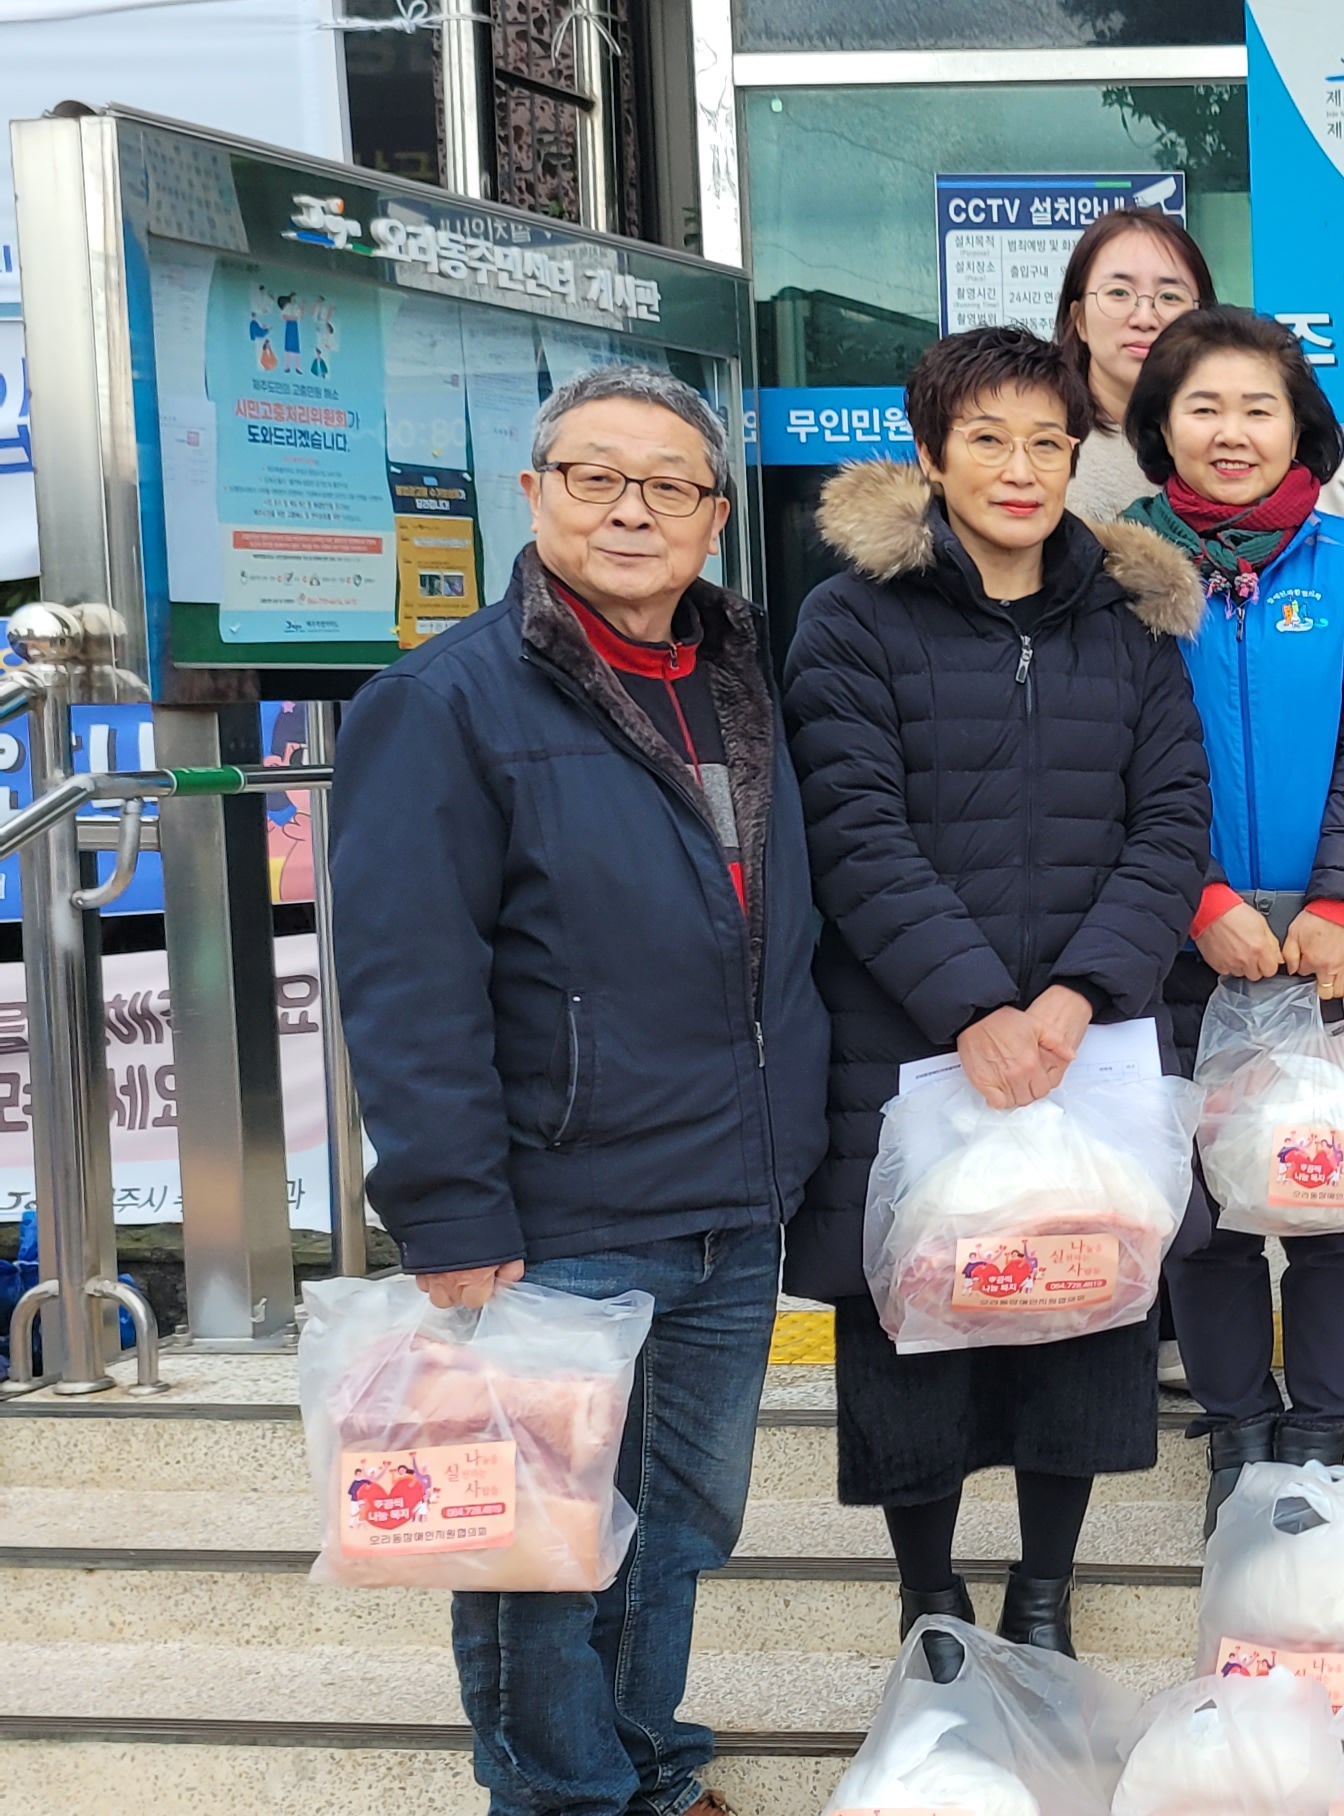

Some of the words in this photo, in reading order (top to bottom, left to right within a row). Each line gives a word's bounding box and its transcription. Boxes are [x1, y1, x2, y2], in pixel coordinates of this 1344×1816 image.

[949, 197, 1020, 224] CCTV
[954, 235, 996, 250] 설치목적
[1007, 239, 1047, 253] 범죄예방
[1049, 240, 1059, 252] 및
[370, 216, 575, 305] 오라동주민센터
[584, 268, 661, 322] 게시판
[955, 259, 996, 274] 설치장소
[1010, 264, 1049, 279] 출입구내
[956, 286, 996, 301] 촬영시간
[1009, 290, 1041, 305] 24시간
[957, 312, 997, 327] 촬영범위
[252, 378, 291, 396] 제주도민의
[292, 384, 323, 400] 고충민원
[235, 399, 360, 431] 시민고충처리위원회가
[786, 408, 914, 443] 무인민원
[247, 424, 351, 453] 도와드리겠습니다.
